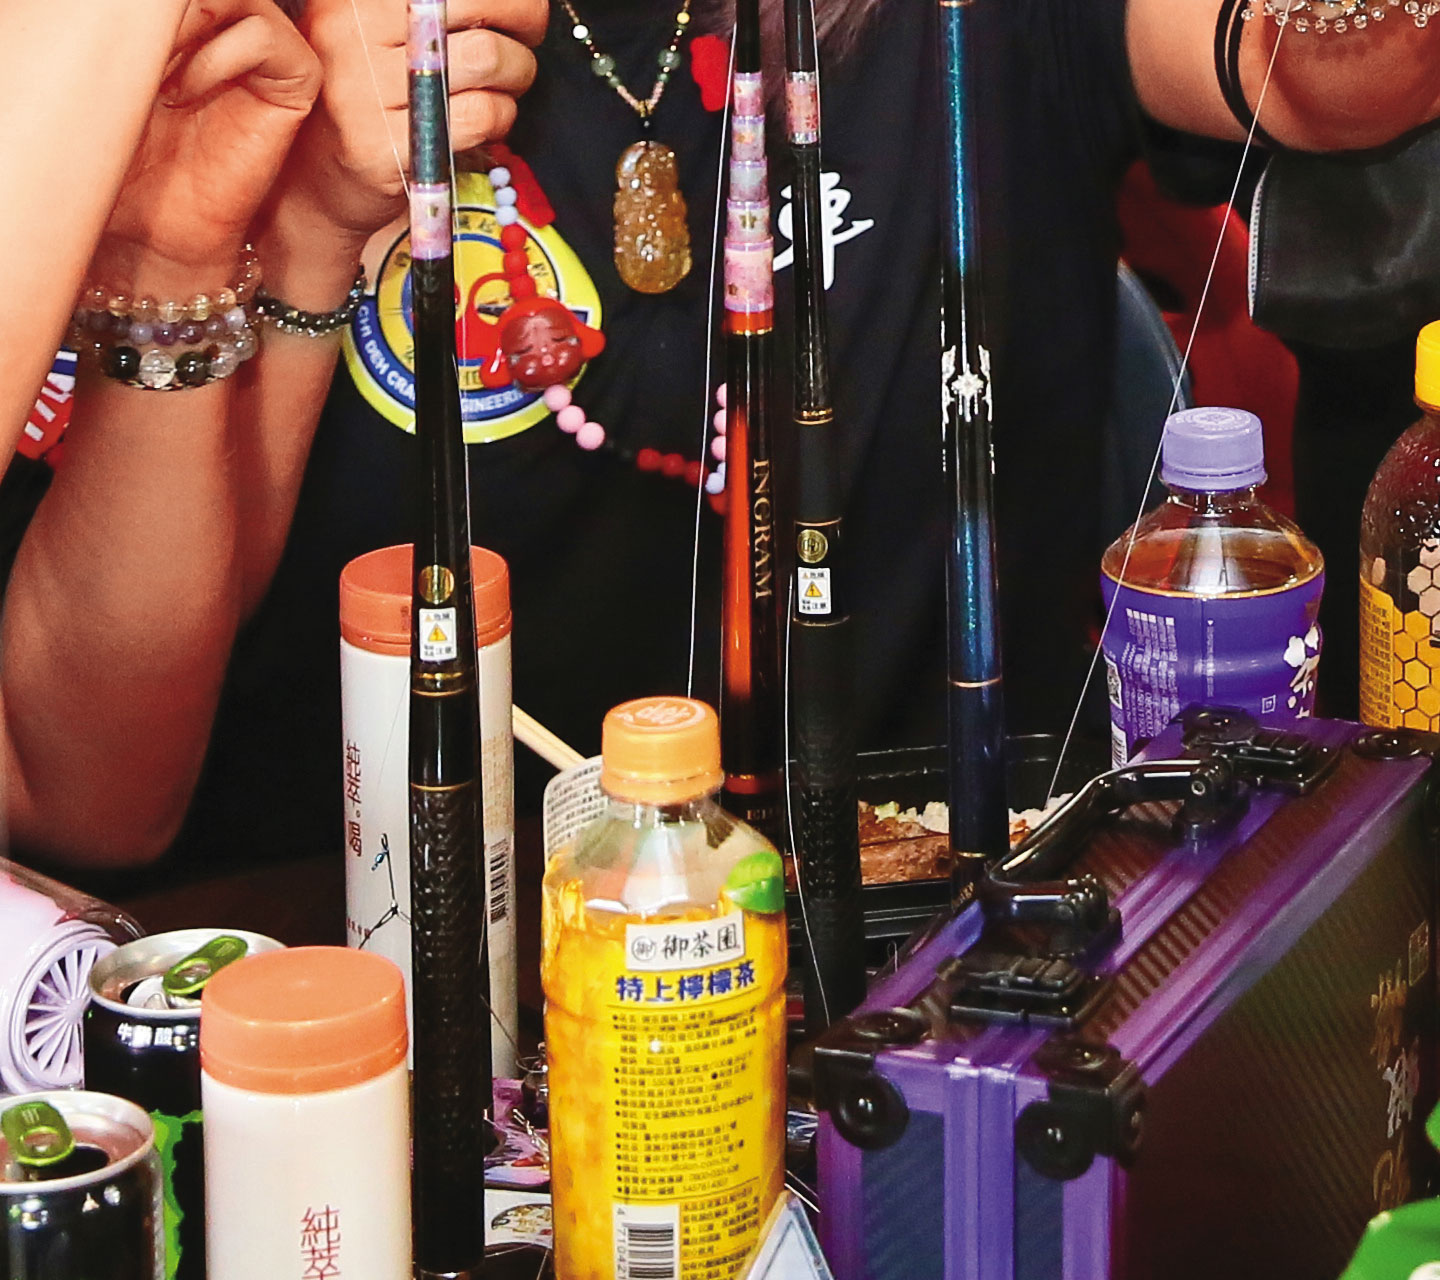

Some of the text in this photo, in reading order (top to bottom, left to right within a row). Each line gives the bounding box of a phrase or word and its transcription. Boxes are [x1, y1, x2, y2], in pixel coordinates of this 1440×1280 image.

[753, 458, 772, 600] INGRAM
[661, 923, 738, 961] 御茶園
[615, 959, 756, 1002] 特上檸檬茶
